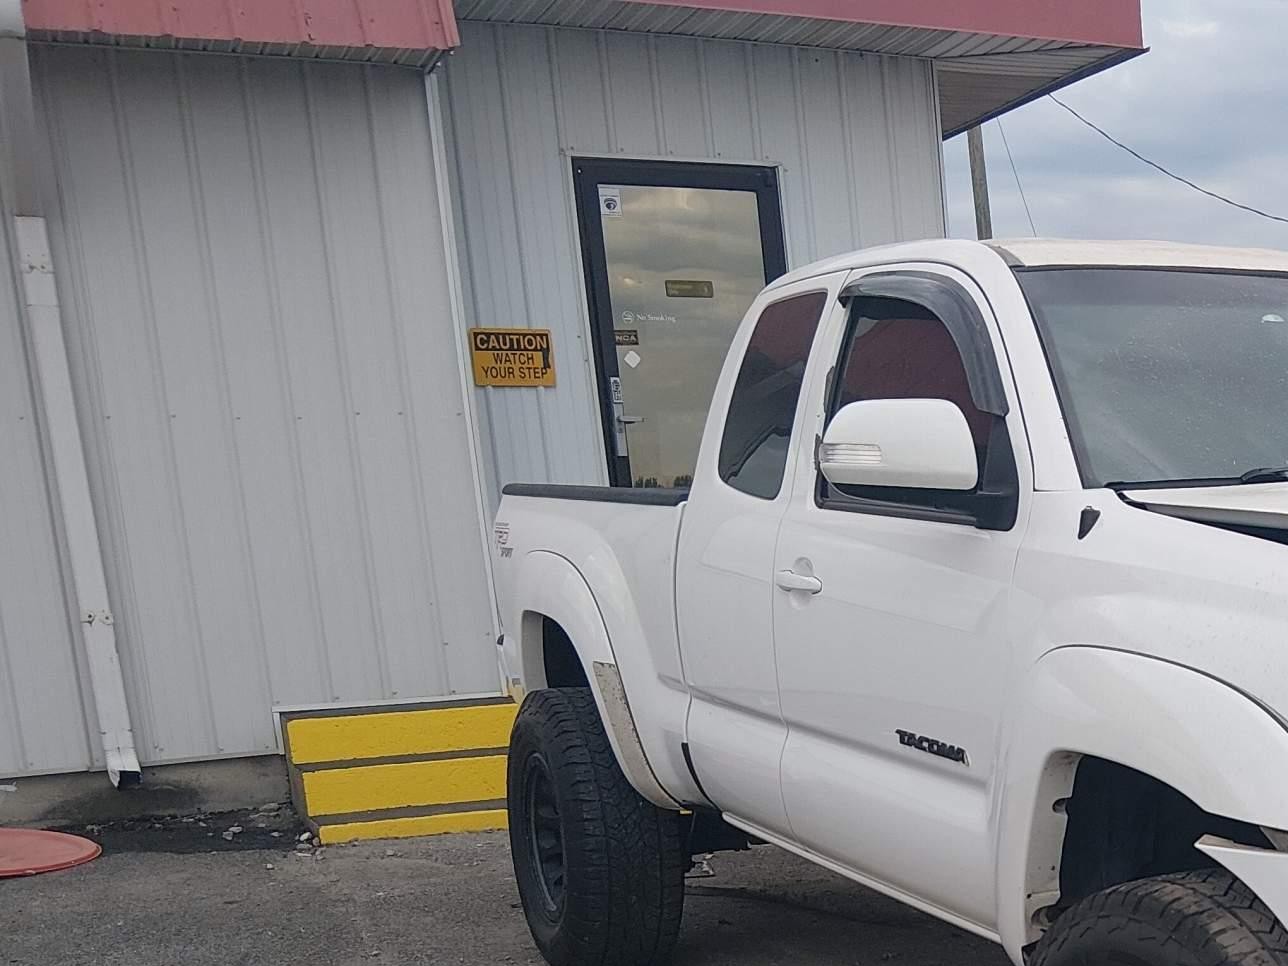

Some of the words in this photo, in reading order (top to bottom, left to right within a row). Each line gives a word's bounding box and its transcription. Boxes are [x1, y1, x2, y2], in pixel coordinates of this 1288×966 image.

[476, 334, 546, 350] CAUTION
[492, 352, 534, 365] WATCH
[481, 366, 515, 379] YOUR
[519, 367, 547, 379] STEP
[895, 729, 969, 767] TACOMA
